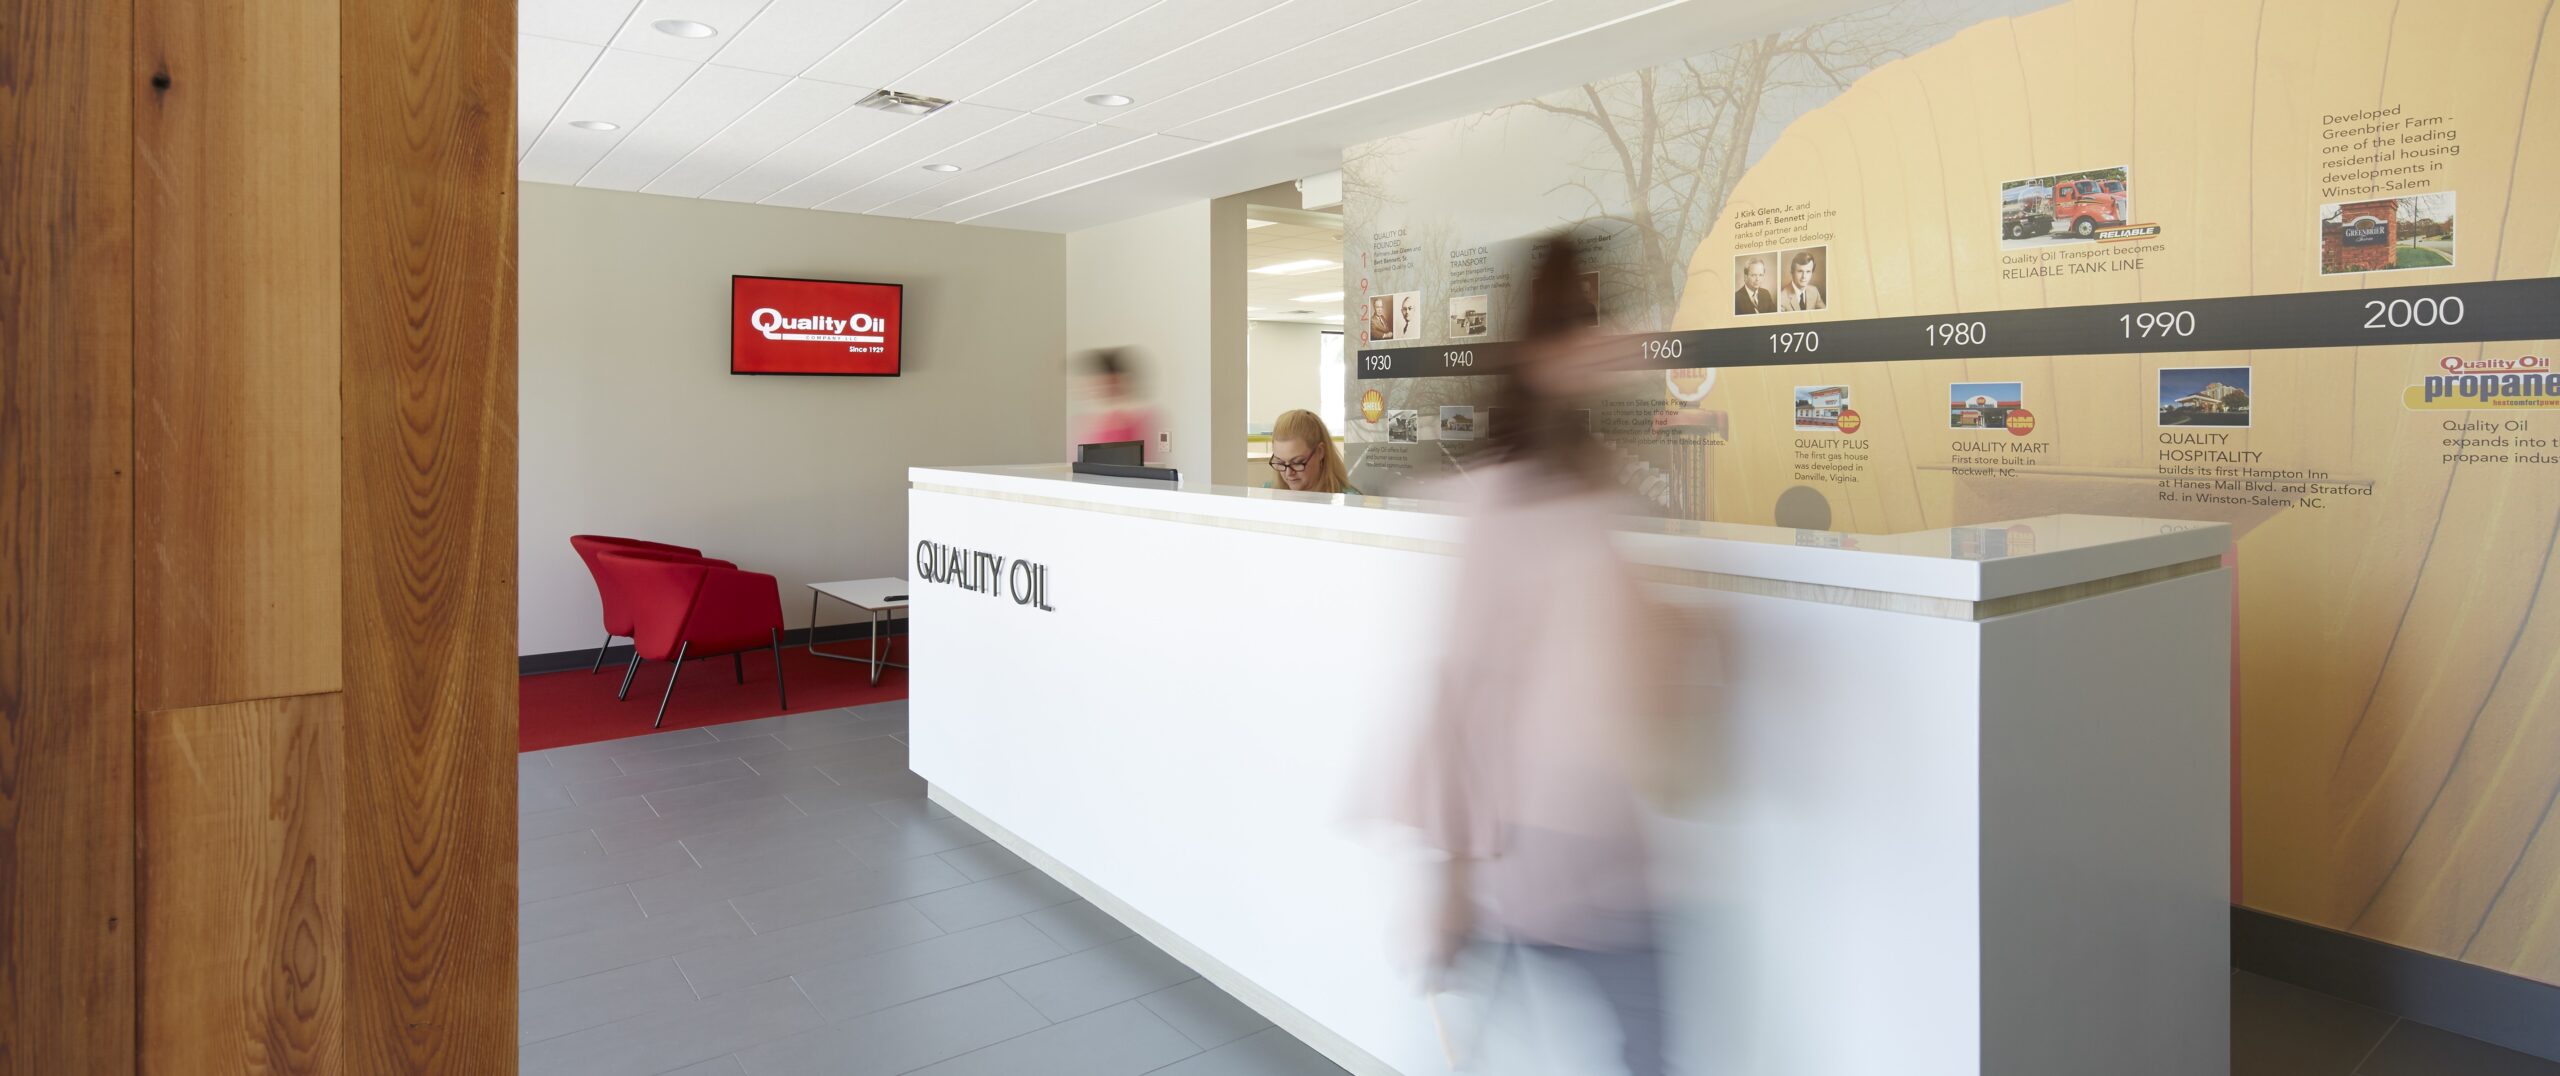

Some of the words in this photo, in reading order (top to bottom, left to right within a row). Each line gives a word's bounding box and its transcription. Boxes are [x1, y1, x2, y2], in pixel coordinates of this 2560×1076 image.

[2323, 104, 2400, 125] Developed
[2323, 120, 2400, 140] Greenbrier
[2406, 116, 2442, 128] Farm
[2322, 144, 2348, 154] one
[2354, 139, 2368, 150] of
[2373, 136, 2396, 148] the
[2401, 129, 2456, 144] leading
[2323, 150, 2396, 168] residential
[2401, 144, 2460, 160] housing
[2322, 164, 2425, 184] developments
[2430, 161, 2442, 171] in
[2322, 178, 2430, 198] Winston-Salem
[1734, 212, 1739, 220] J
[1741, 209, 1756, 218] Kirk
[1758, 207, 1782, 216] Glenn,
[1784, 204, 1794, 212] Jr.
[1796, 200, 1810, 210] and
[1734, 220, 1764, 230] Graham
[1774, 214, 1805, 224] Bennett
[1807, 210, 1821, 221] join
[1823, 209, 1836, 217] the
[1374, 230, 1396, 240] QUALITY
[1734, 230, 1753, 240] ranks
[1755, 228, 1762, 237] of
[1764, 226, 1792, 237] partner
[1794, 224, 1808, 232] and
[2100, 227, 2154, 240] RELIABLE
[1374, 240, 1401, 250] FOUNDED
[1734, 240, 1764, 250] develop
[1765, 238, 1778, 246] the
[1780, 236, 1798, 244] Core
[1800, 232, 1836, 242] Ideology.
[1450, 248, 1476, 258] QUALITY
[1478, 246, 1488, 254] OIL
[2002, 254, 2038, 265] Quality
[2040, 251, 2056, 262] Oil
[2060, 248, 2110, 260] Transport
[2114, 244, 2164, 255] becomes
[1450, 256, 1487, 268] TRANSPORT
[2002, 265, 2064, 280] RELIABLE
[2068, 261, 2106, 275] TANK
[2112, 258, 2144, 271] LINE
[2364, 296, 2464, 328] 2000
[752, 308, 846, 335] Quality
[850, 313, 885, 333] Oil
[2120, 310, 2196, 338] 1990
[1926, 322, 1986, 346] 1980
[1641, 339, 1682, 360] 1960
[1769, 332, 1819, 353] 1970
[1365, 355, 1392, 371] 1930
[1444, 350, 1474, 368] 1940
[2440, 356, 2515, 370] Quality
[2519, 356, 2549, 368] Oil
[2425, 374, 2560, 402] propane
[1650, 399, 1669, 407] Creek
[1670, 399, 1688, 408] Pkwy
[1631, 418, 1654, 428] Quality
[2443, 420, 2499, 434] Quality
[2504, 420, 2528, 431] Oil
[1652, 428, 1670, 437] being
[2160, 433, 2229, 445] QUALITY
[1680, 438, 1701, 446] United
[1794, 438, 1840, 448] QUALITY
[1843, 440, 1869, 450] PLUS
[1952, 442, 2006, 452] QUALITY
[2011, 442, 2050, 453] MART
[2442, 436, 2509, 448] expands
[2515, 436, 2546, 448] into
[1795, 451, 1808, 459] The
[1812, 452, 1826, 460] first
[1828, 454, 1842, 462] gas
[1844, 452, 1868, 460] house
[1952, 454, 1972, 464] First
[1974, 456, 1998, 464] store
[2002, 456, 2024, 465] built
[2026, 457, 2036, 466] in
[2160, 450, 2263, 463] HOSPITALITY
[2442, 454, 2508, 464] propane
[2515, 452, 2560, 464] indus
[1811, 462, 1854, 472] developed
[1952, 466, 1996, 478] Rockwell,
[2000, 468, 2018, 478] NC.
[2159, 465, 2194, 475] builds
[2198, 466, 2212, 476] its
[2216, 466, 2238, 477] first
[2243, 468, 2303, 481] Hampton
[2308, 470, 2328, 480] Inn
[1795, 472, 1828, 482] Danville,
[2158, 480, 2170, 488] at
[2174, 479, 2210, 490] Hanes
[2215, 480, 2241, 492] Mall
[2246, 482, 2276, 493] Blvd.
[2282, 483, 2306, 494] and
[2310, 484, 2372, 496] Stratford
[2159, 492, 2178, 502] Rd.
[2182, 492, 2192, 502] in
[2196, 494, 2295, 508] Winston-Salem,
[2300, 498, 2326, 509] NC.
[916, 540, 1002, 597] QUALITY
[1010, 559, 1052, 612] OIL
